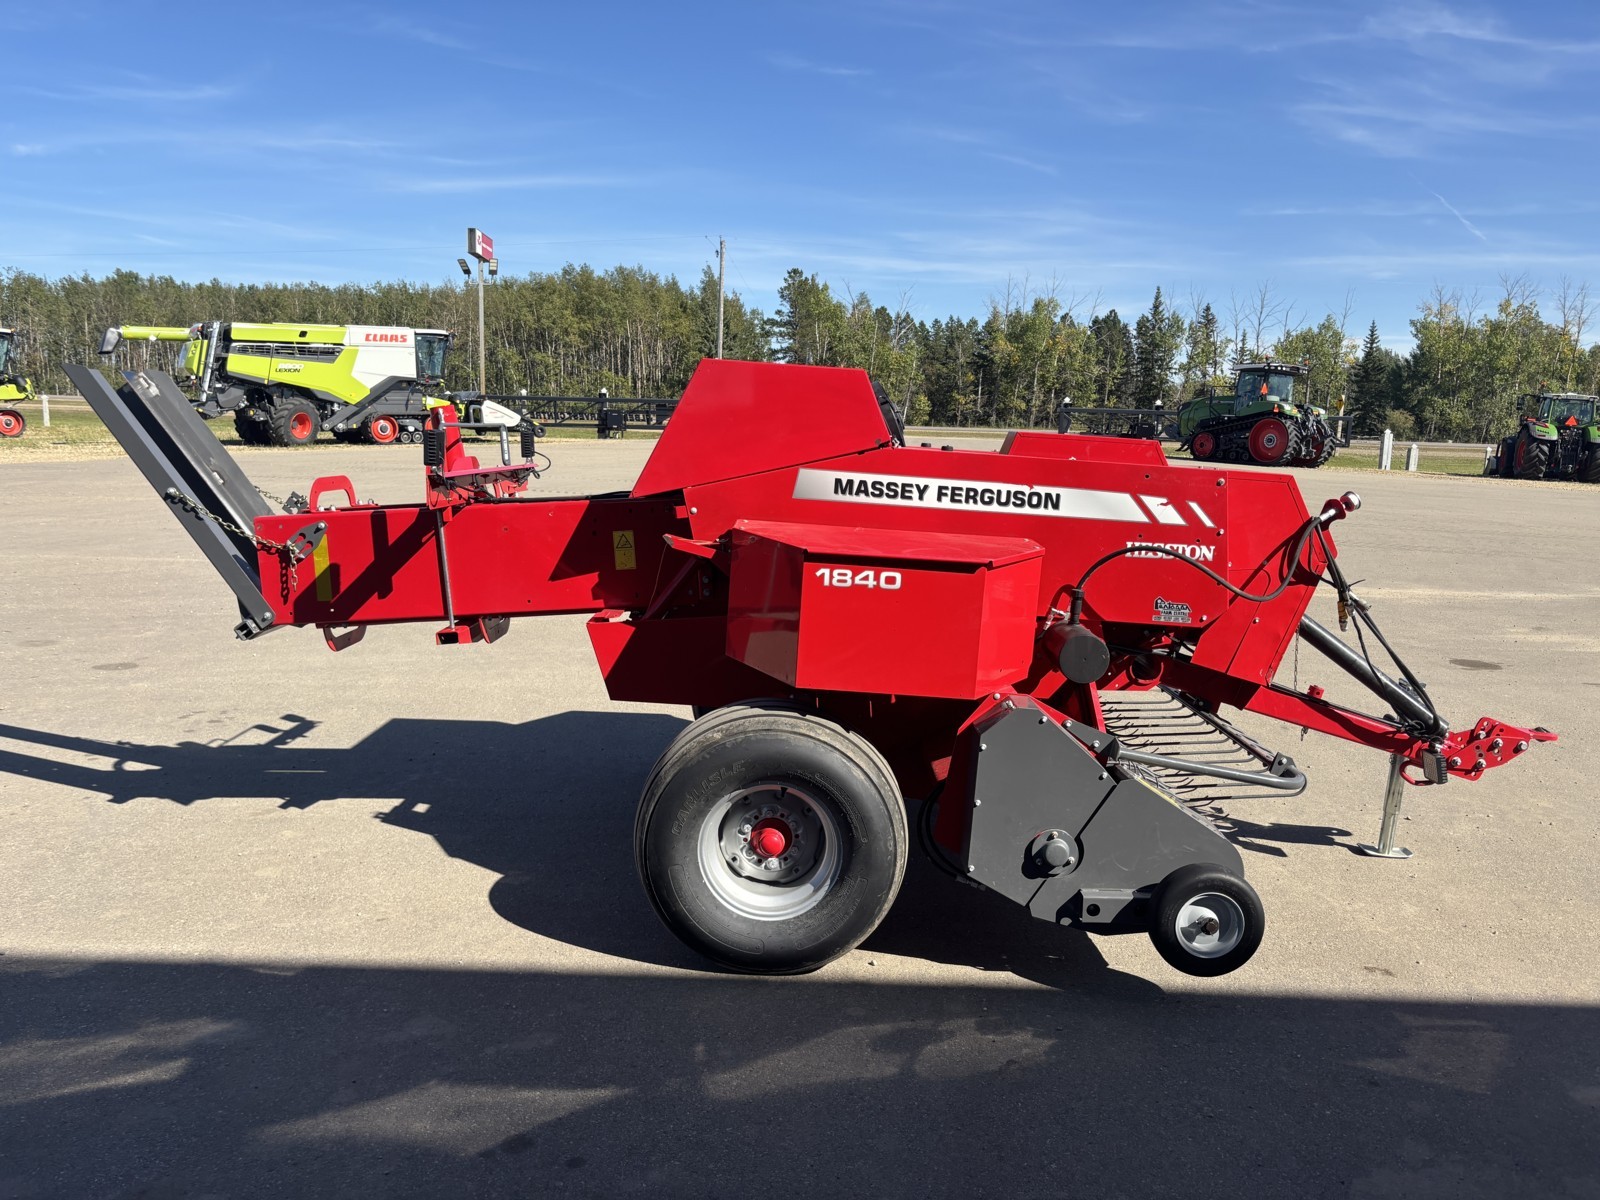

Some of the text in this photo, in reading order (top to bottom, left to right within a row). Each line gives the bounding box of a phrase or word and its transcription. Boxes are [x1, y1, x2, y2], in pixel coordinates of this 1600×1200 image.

[364, 333, 408, 343] CLAAS
[833, 478, 1061, 510] MASSEY FERGUSON
[815, 568, 903, 590] 1840
